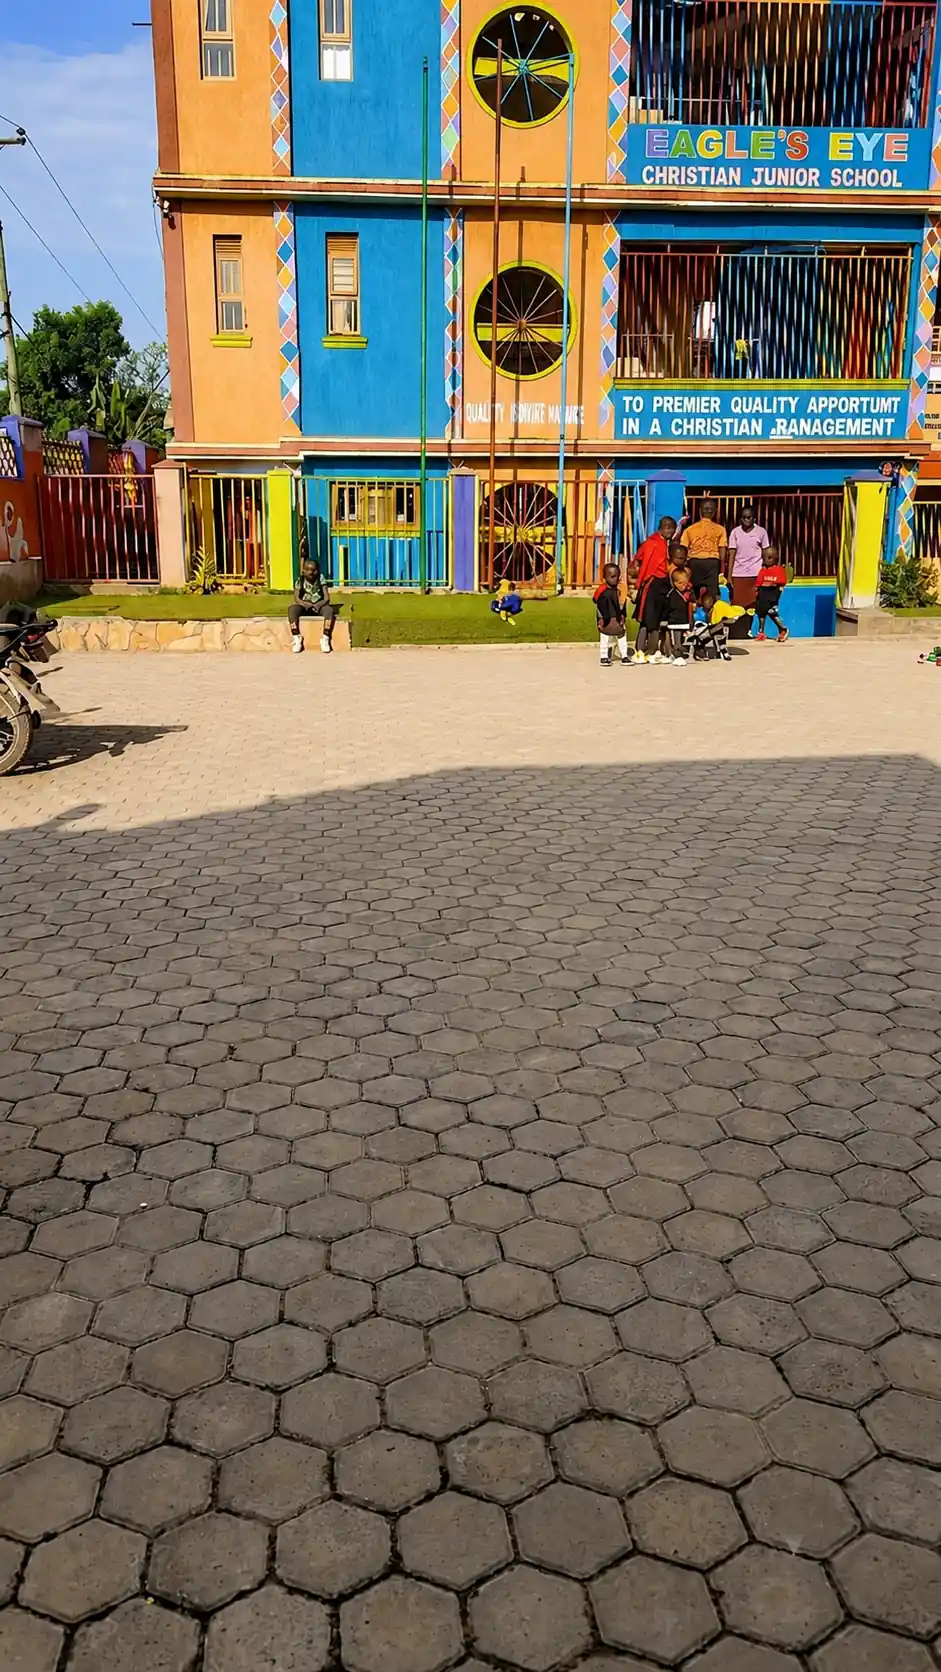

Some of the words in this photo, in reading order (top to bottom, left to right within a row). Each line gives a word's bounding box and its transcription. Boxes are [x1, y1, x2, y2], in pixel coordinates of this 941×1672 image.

[645, 128, 809, 160] EAGLE'S
[829, 132, 909, 162] EYE
[642, 165, 741, 186] CHRISTIAN
[751, 167, 820, 187] JUNIOR
[830, 168, 903, 188] SCHOOL
[622, 396, 644, 413] TO
[652, 396, 721, 413] PREMIER
[731, 396, 799, 414] QUALITY
[622, 418, 640, 435] IN
[649, 418, 662, 435] A
[671, 418, 763, 436] CHRISTIAN
